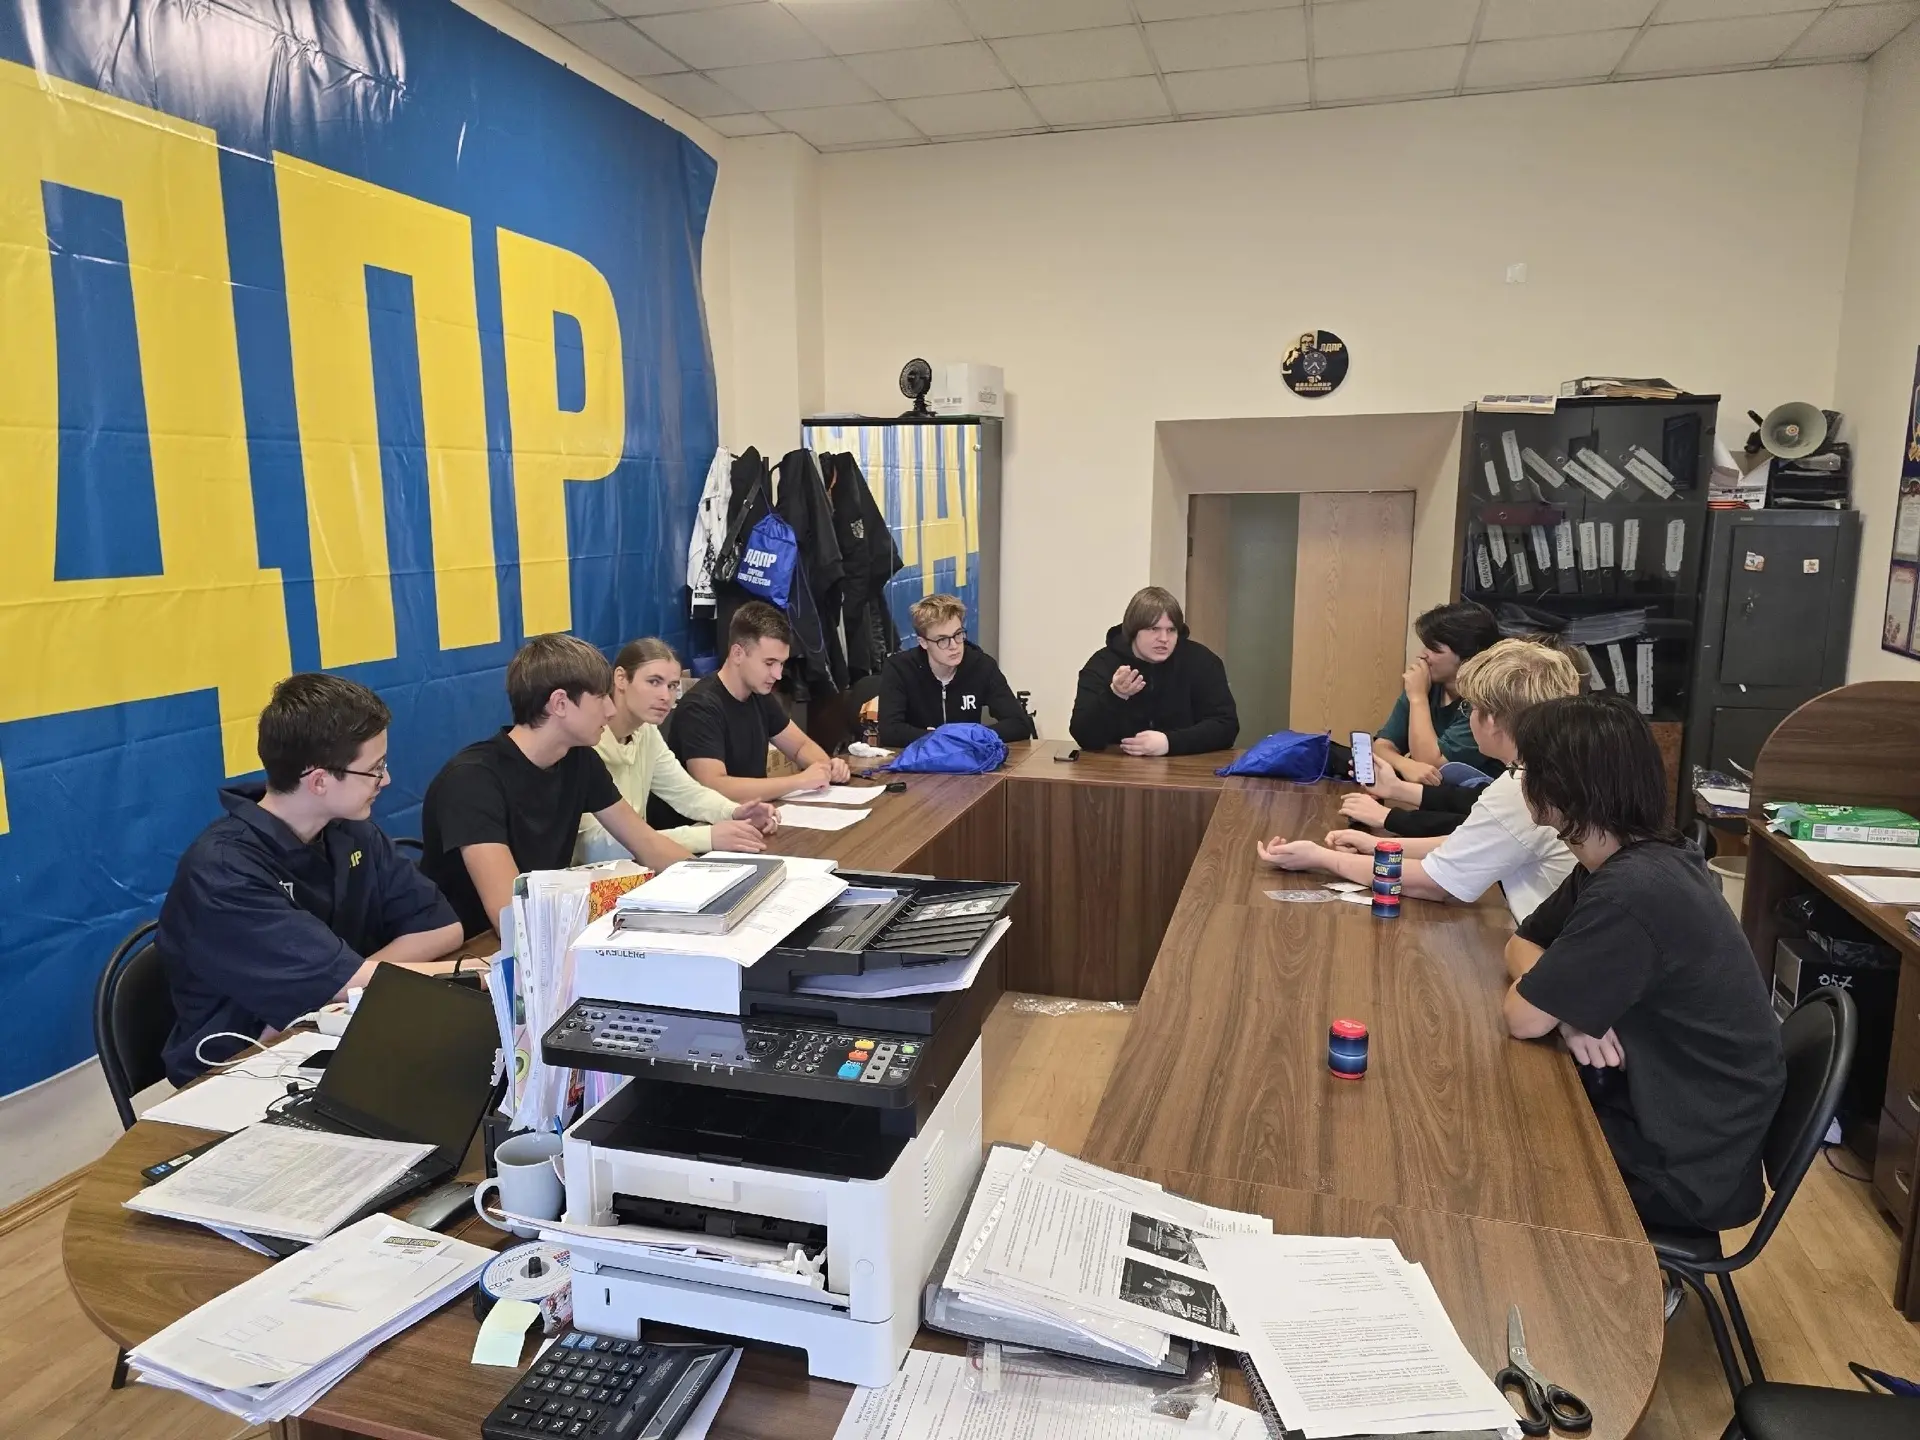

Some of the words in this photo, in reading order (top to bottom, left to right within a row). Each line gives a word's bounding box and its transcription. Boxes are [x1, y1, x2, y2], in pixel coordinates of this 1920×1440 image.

[1320, 343, 1342, 353] ЛДПР
[743, 548, 778, 568] ЛДПР
[960, 694, 977, 711] JR
[488, 1277, 514, 1291] CD-R
